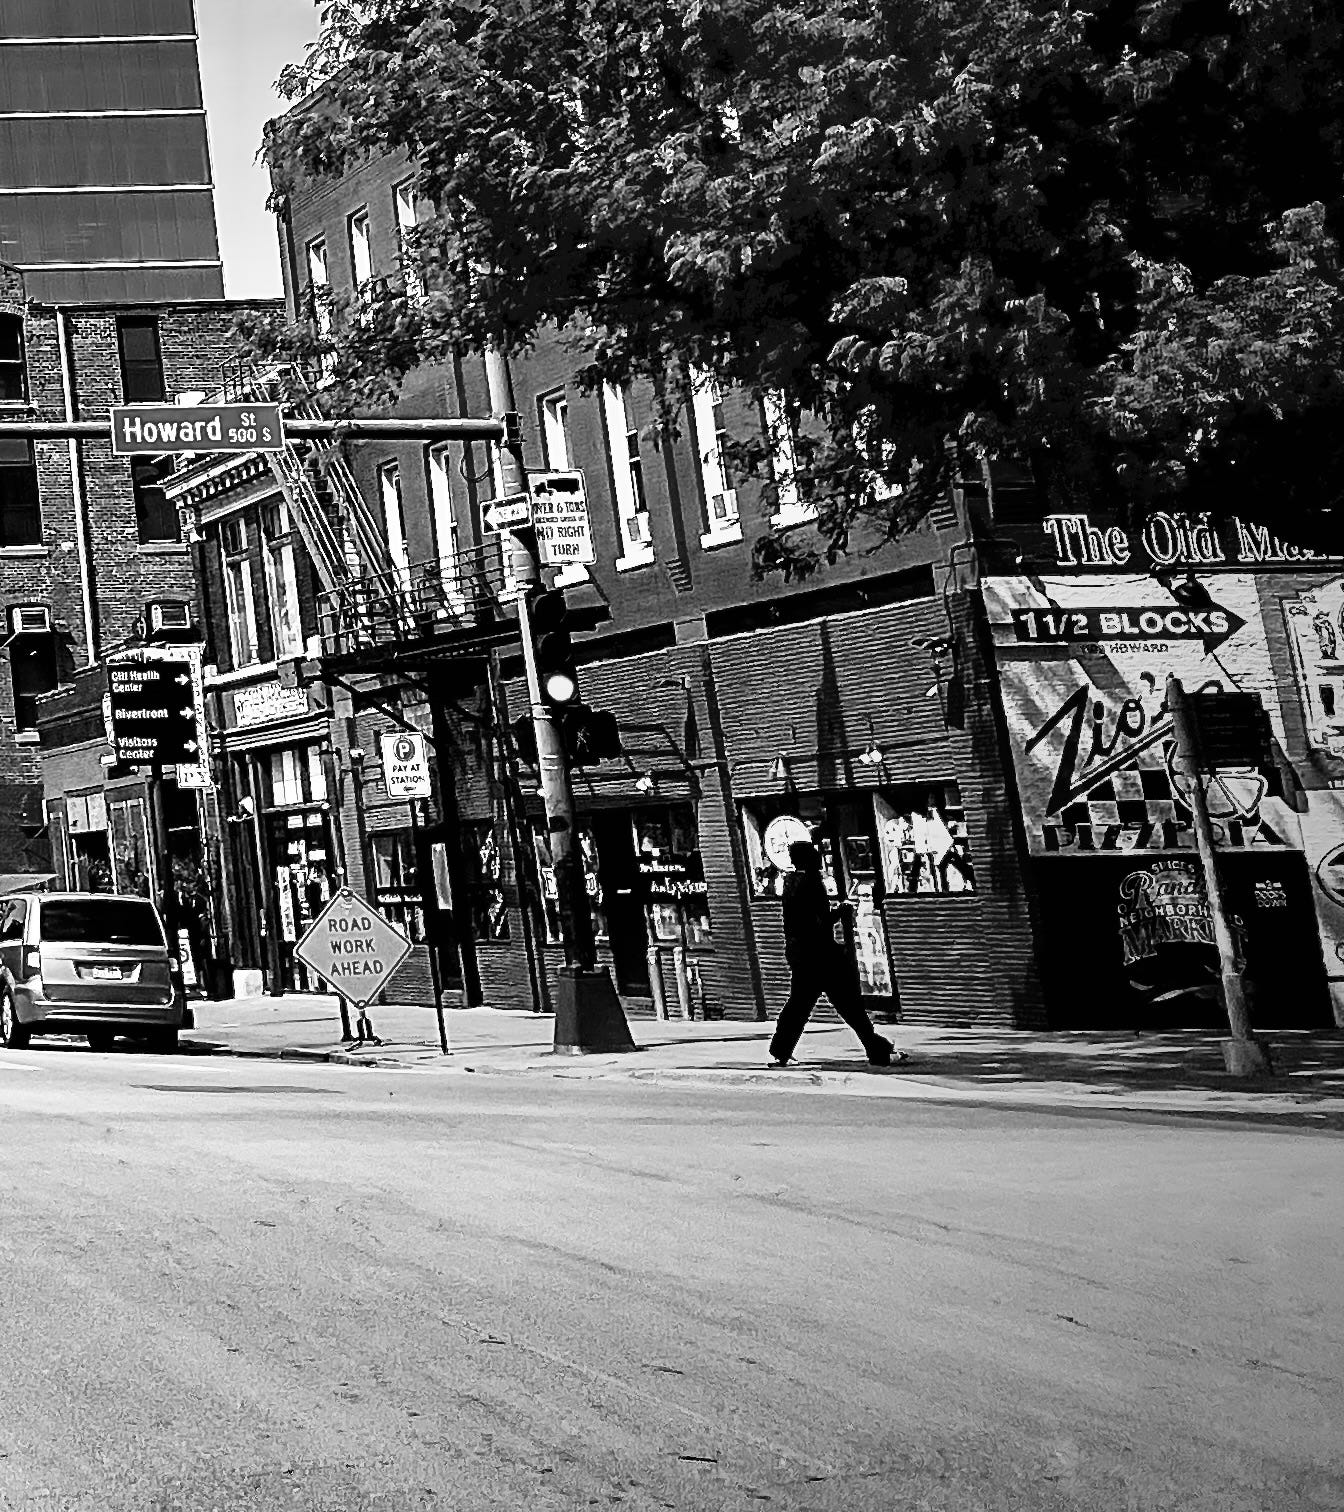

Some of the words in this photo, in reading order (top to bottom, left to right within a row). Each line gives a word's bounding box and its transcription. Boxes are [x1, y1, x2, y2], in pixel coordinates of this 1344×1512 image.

[240, 412, 256, 427] St
[123, 416, 222, 443] Howard
[228, 428, 257, 443] 500
[262, 427, 272, 442] S
[557, 525, 585, 538] RIGHT
[1043, 514, 1131, 566] The
[1141, 511, 1226, 565] Old
[551, 543, 580, 556] TURN
[1099, 611, 1229, 634] BLOCKS
[1109, 642, 1169, 654] HOWARD
[129, 670, 160, 681] Health
[112, 682, 143, 693] Center
[115, 708, 169, 720] Riverfront
[118, 737, 158, 748] Visitors
[119, 749, 155, 759] Center
[392, 764, 408, 773] PAY
[411, 763, 421, 772] AT
[391, 775, 426, 785] STATION
[327, 916, 372, 933] ROAD
[330, 938, 375, 955] WORK
[330, 959, 384, 977] AHEAD
